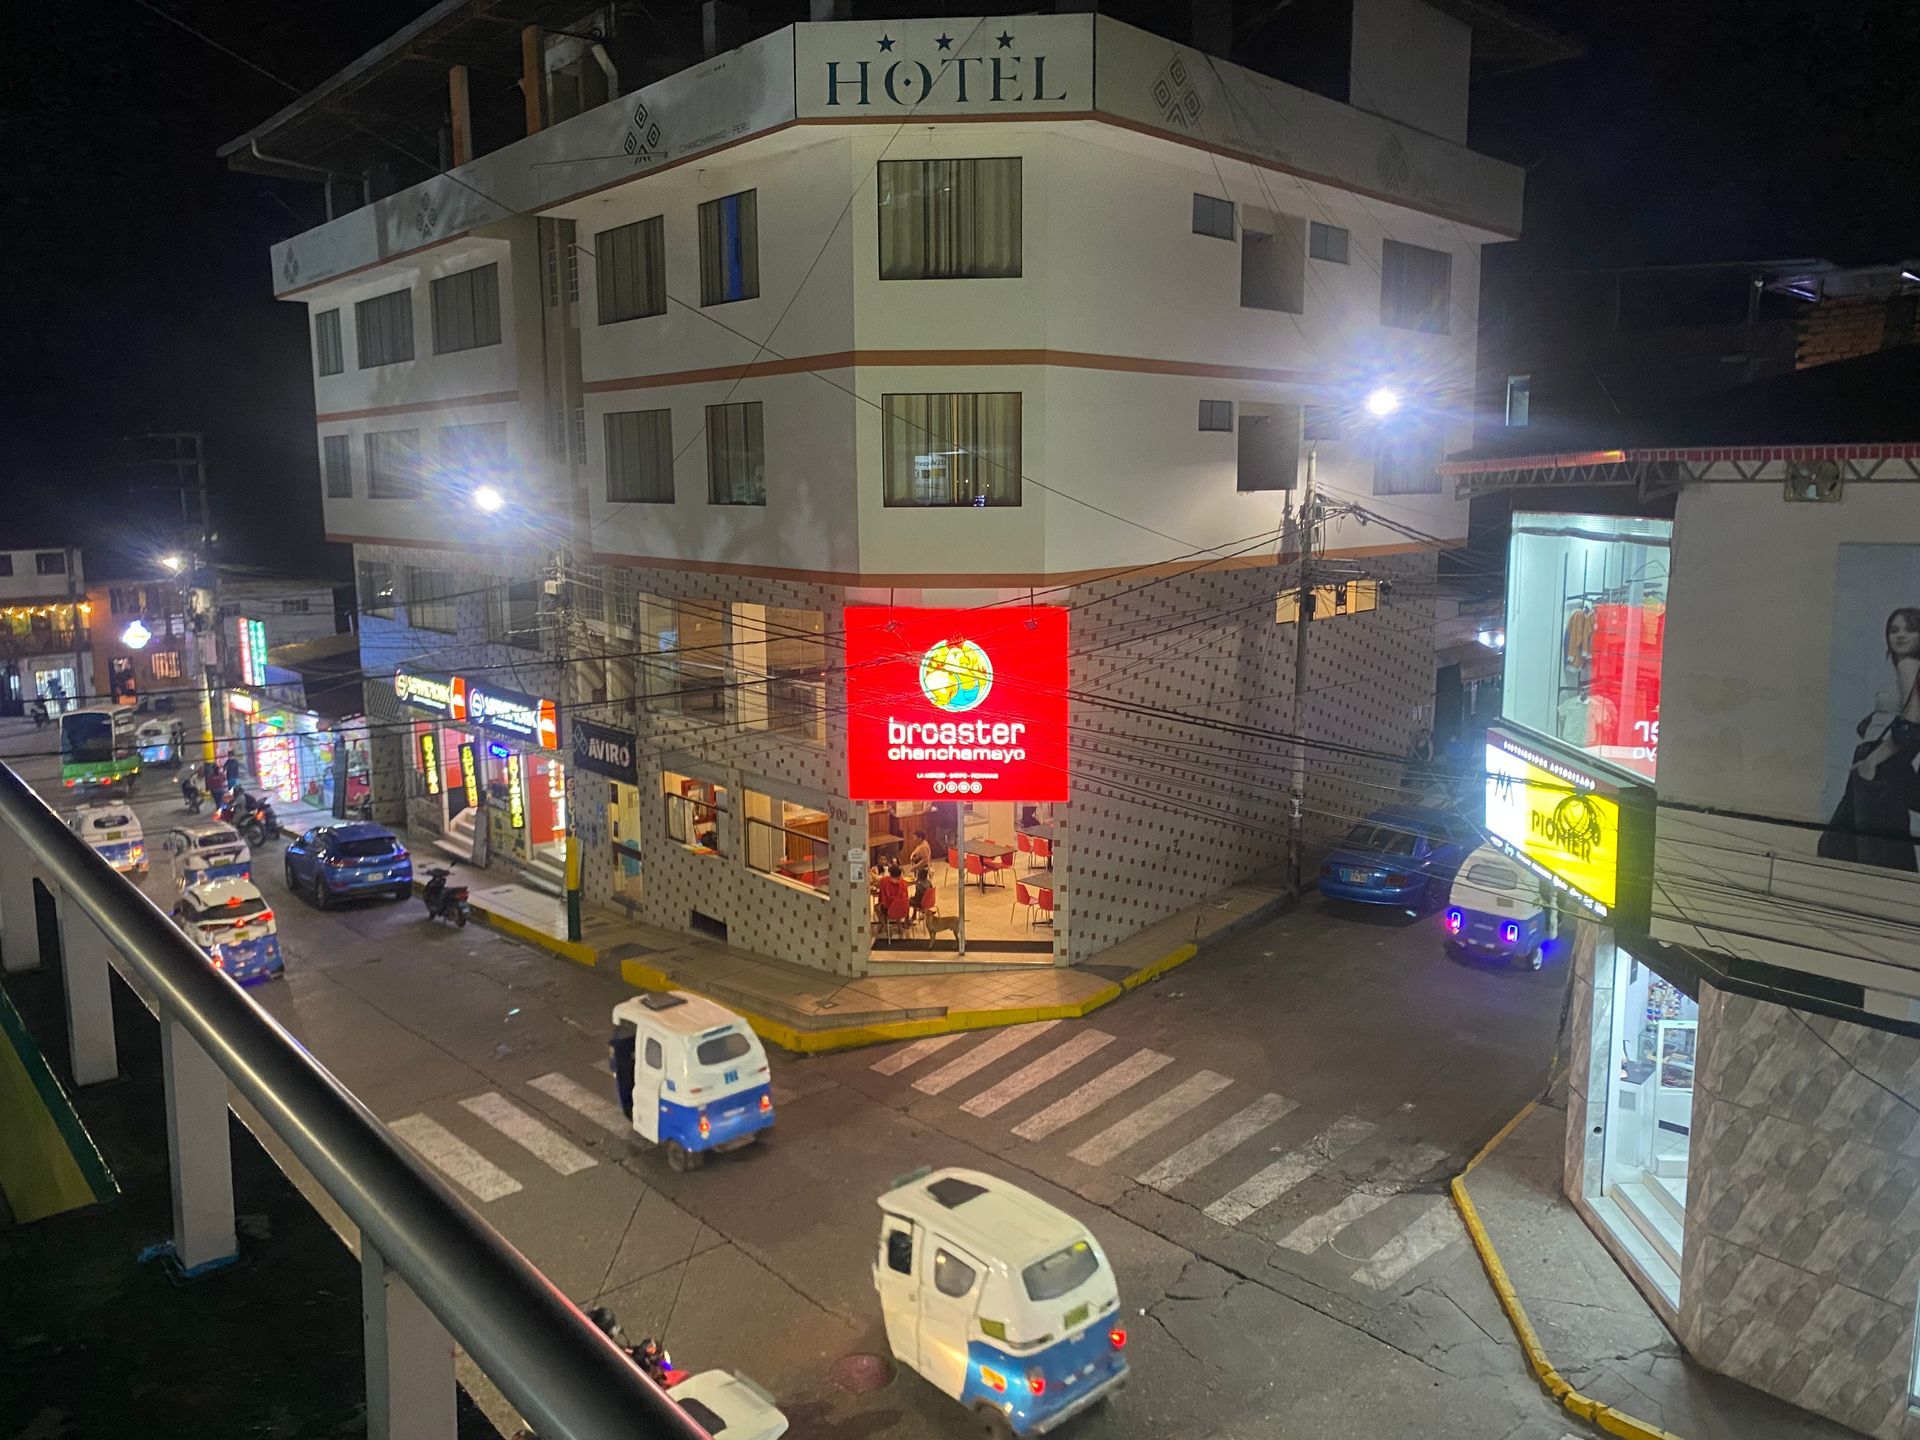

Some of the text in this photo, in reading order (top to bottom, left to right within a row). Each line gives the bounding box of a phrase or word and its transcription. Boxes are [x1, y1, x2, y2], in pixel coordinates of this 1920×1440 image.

[825, 56, 1067, 106] HOTEL
[888, 716, 1026, 745] broaster
[888, 744, 1026, 764] chanchamayo
